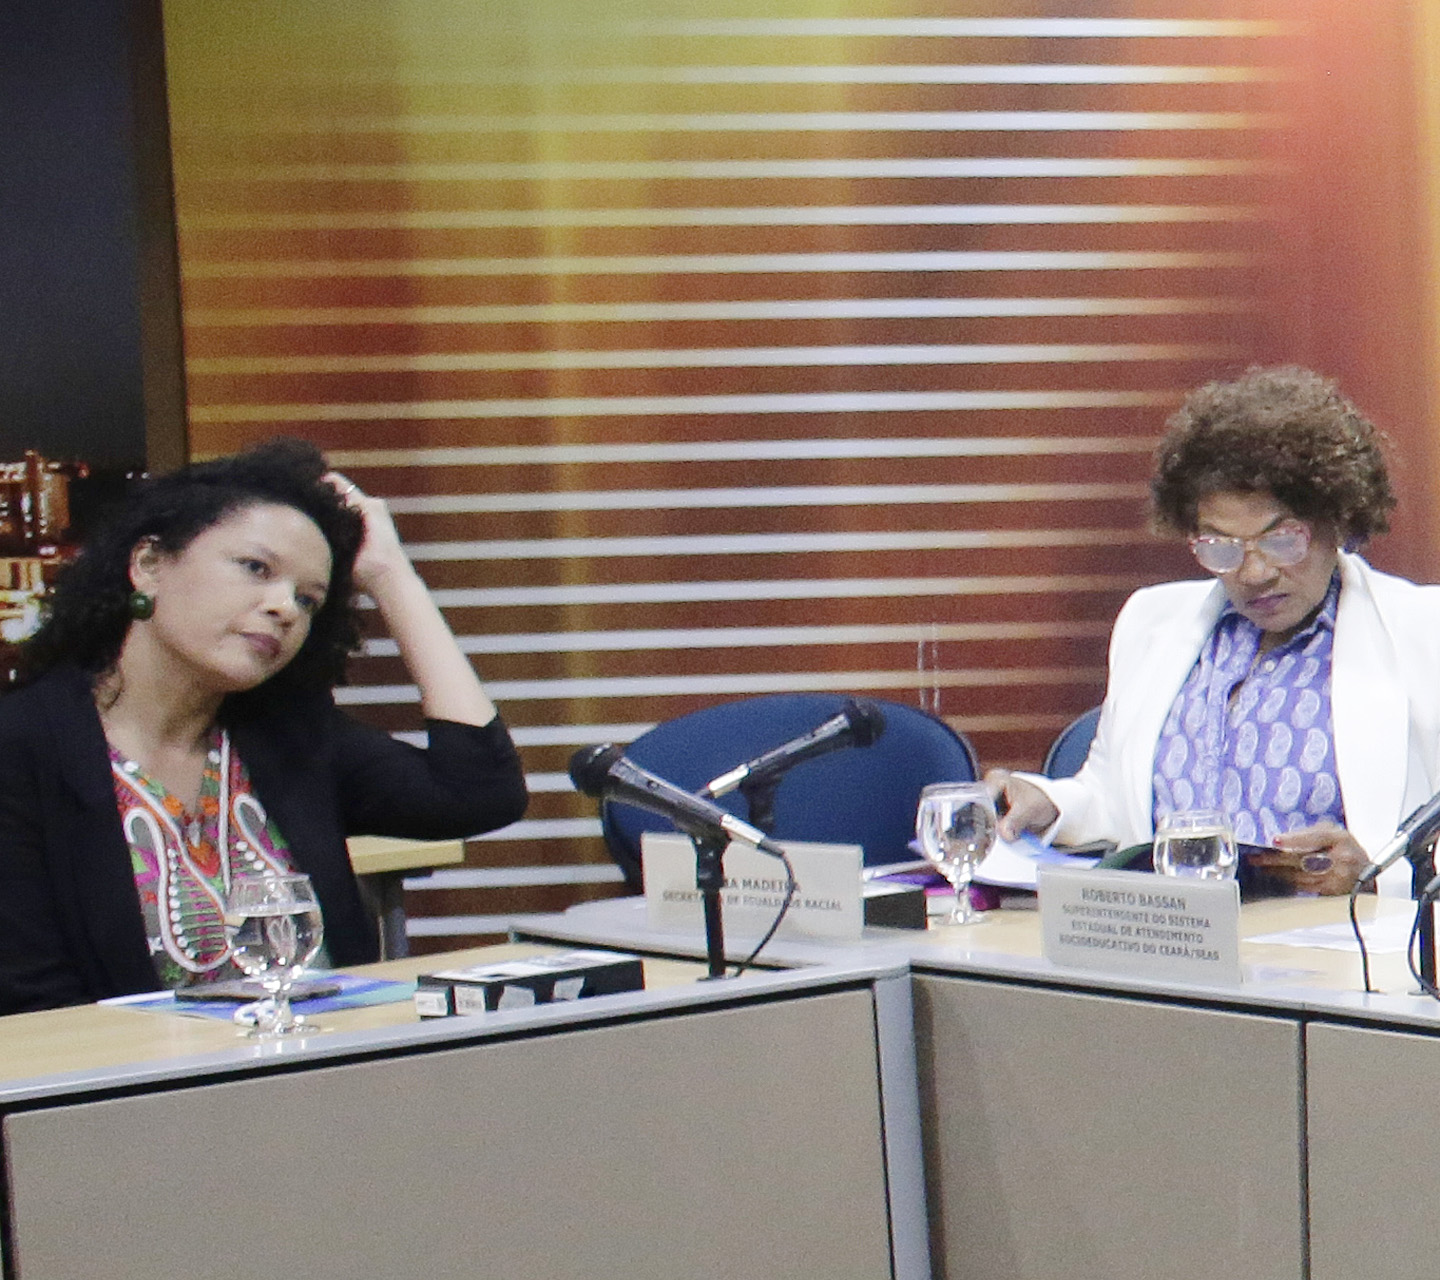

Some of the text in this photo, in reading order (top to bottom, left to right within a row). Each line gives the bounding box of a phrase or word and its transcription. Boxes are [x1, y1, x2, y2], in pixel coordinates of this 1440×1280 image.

[1082, 888, 1187, 910] ROBERTO BASSAN
[1072, 920, 1204, 943] ESTADUAL DE ATENDIMENTO
[1169, 914, 1211, 928] SISTEMA
[1059, 934, 1140, 952] SOCIOEDUCATIVO
[1143, 943, 1156, 954] DO
